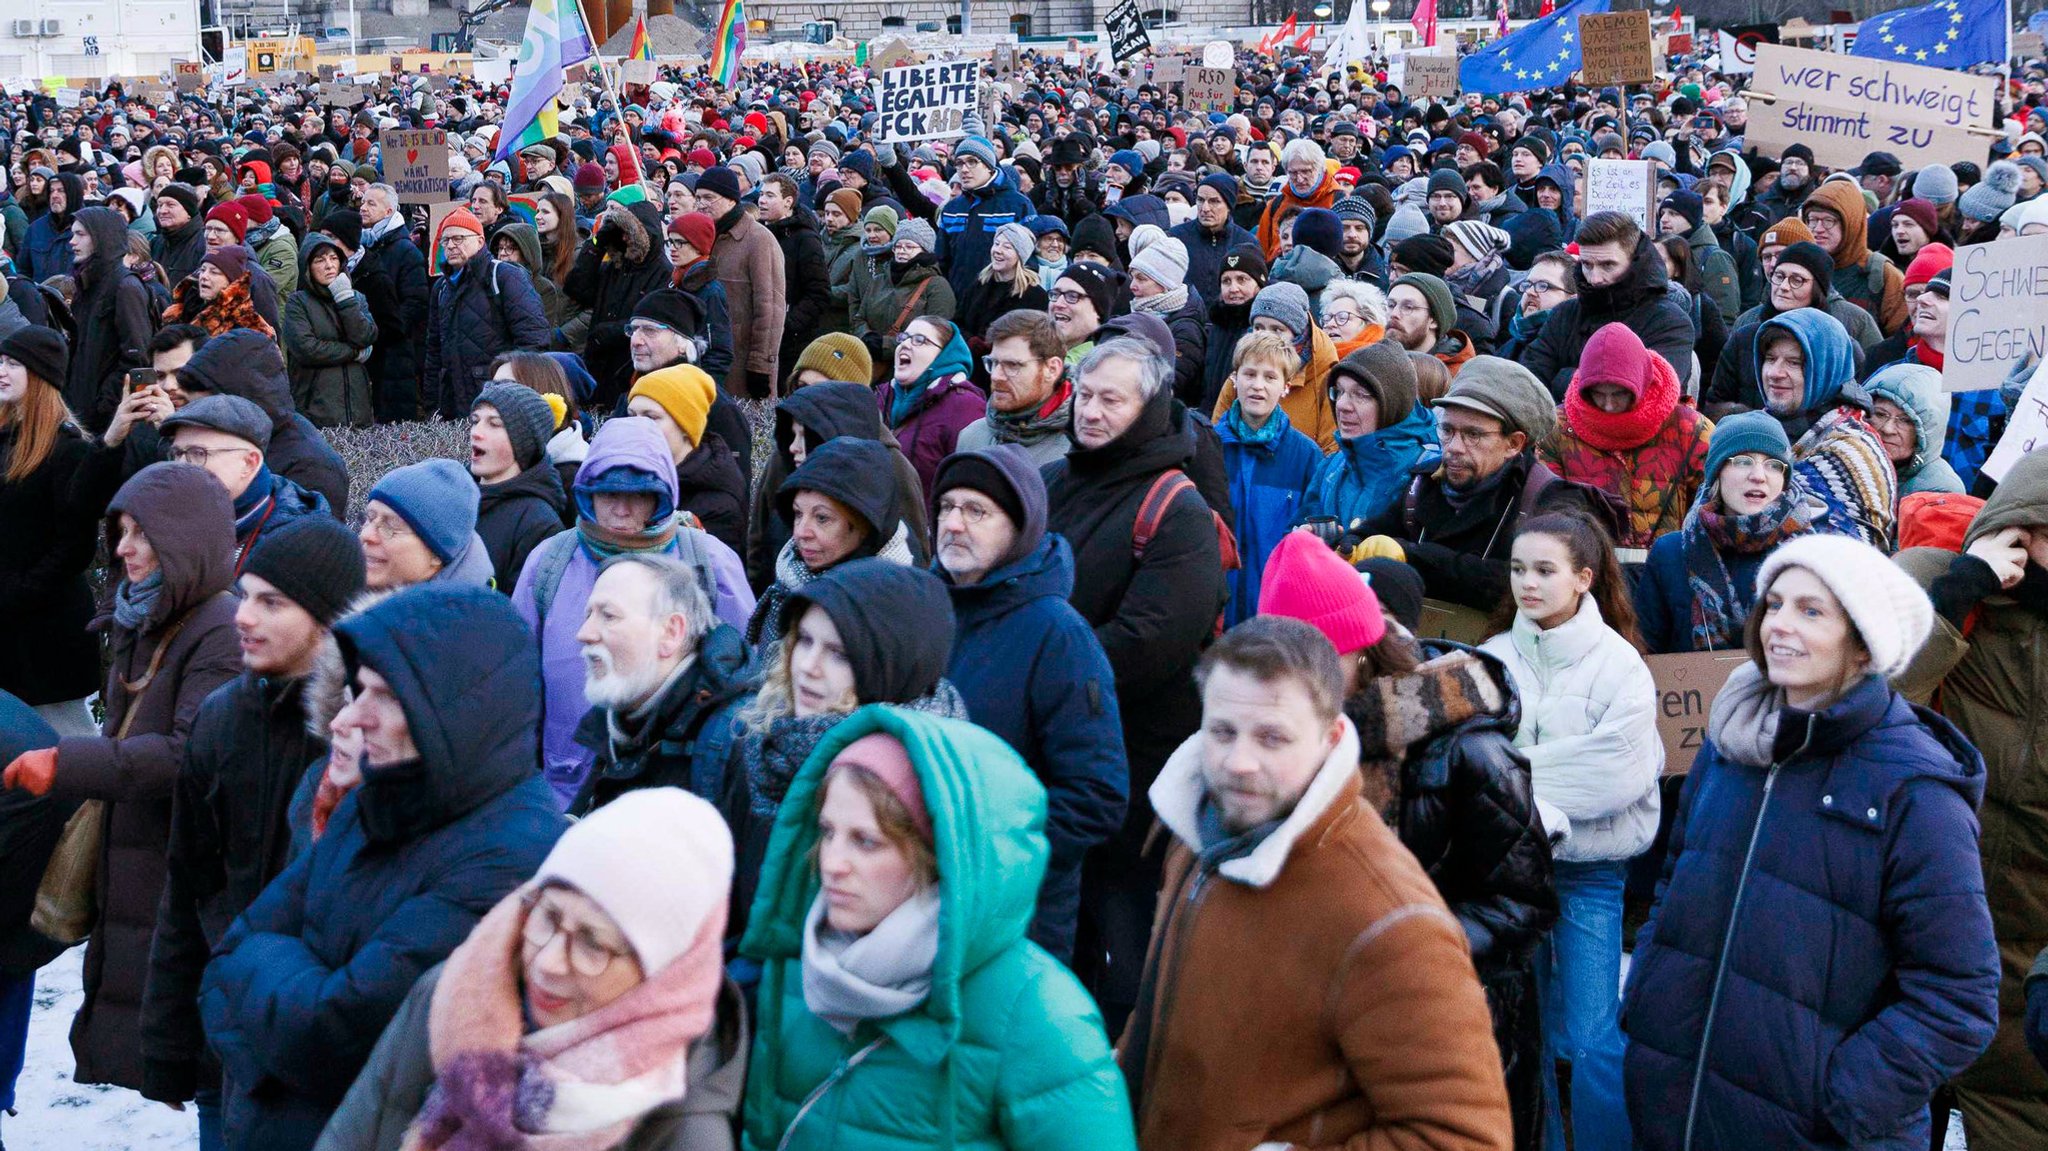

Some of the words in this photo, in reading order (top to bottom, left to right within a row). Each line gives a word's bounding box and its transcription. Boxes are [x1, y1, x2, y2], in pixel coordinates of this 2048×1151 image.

[83, 36, 98, 46] FCK
[1584, 30, 1638, 45] UNSERE
[85, 46, 100, 56] AFD
[180, 64, 199, 75] FCK
[1406, 57, 1422, 73] Nie
[1424, 62, 1450, 74] wieder
[1587, 56, 1643, 70] WOLLEN
[1404, 76, 1414, 86] ist
[882, 82, 977, 113] ÉGALITÉ
[1188, 88, 1204, 99] Aus
[1848, 70, 1980, 126] schweigt
[394, 177, 448, 194] DEMOKRATISCH
[1629, 181, 1640, 190] es
[1656, 688, 1702, 718] en
